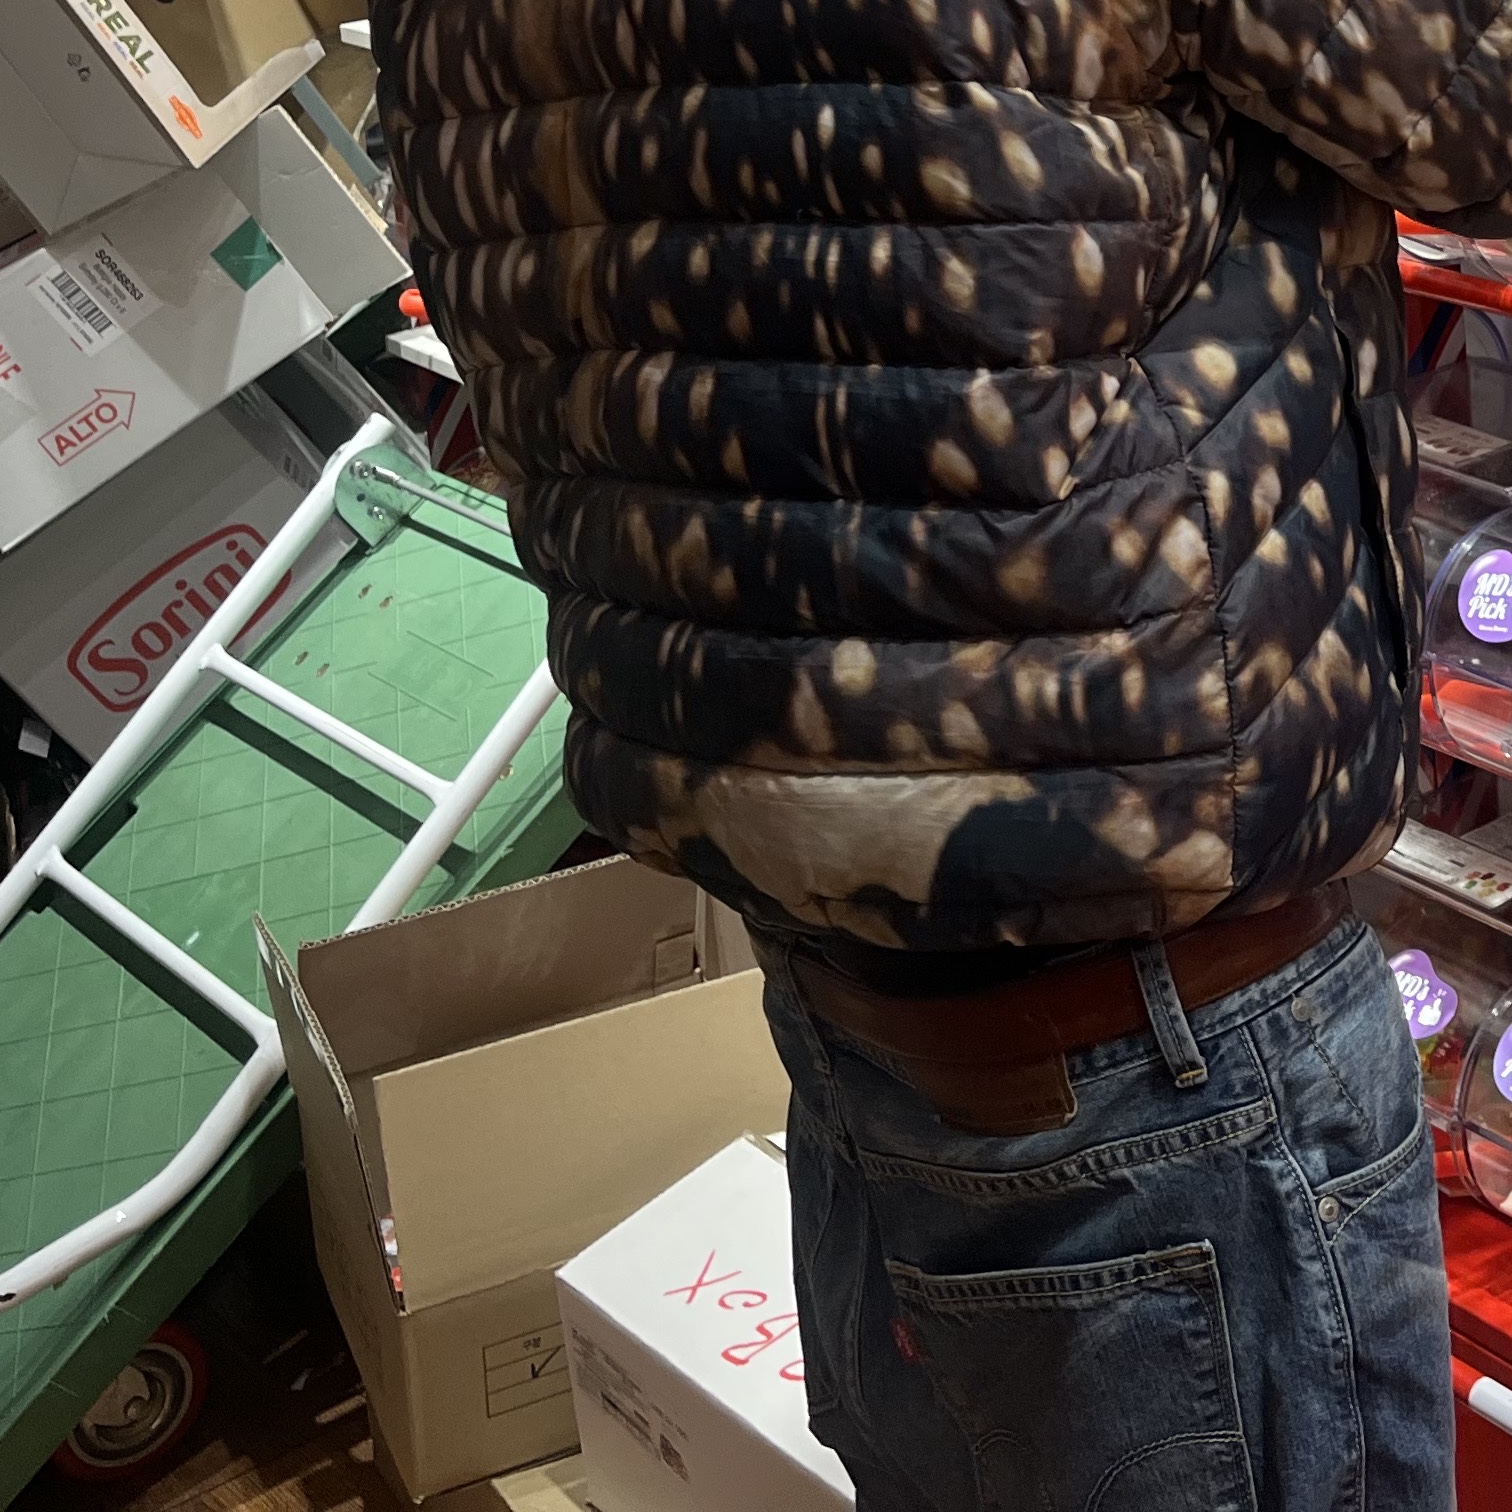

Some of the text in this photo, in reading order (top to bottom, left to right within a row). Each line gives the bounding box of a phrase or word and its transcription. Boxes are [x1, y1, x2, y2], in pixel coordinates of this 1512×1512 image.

[54, 401, 119, 457] ALTO
[87, 539, 255, 696] Sorini
[1467, 595, 1509, 620] Pick
